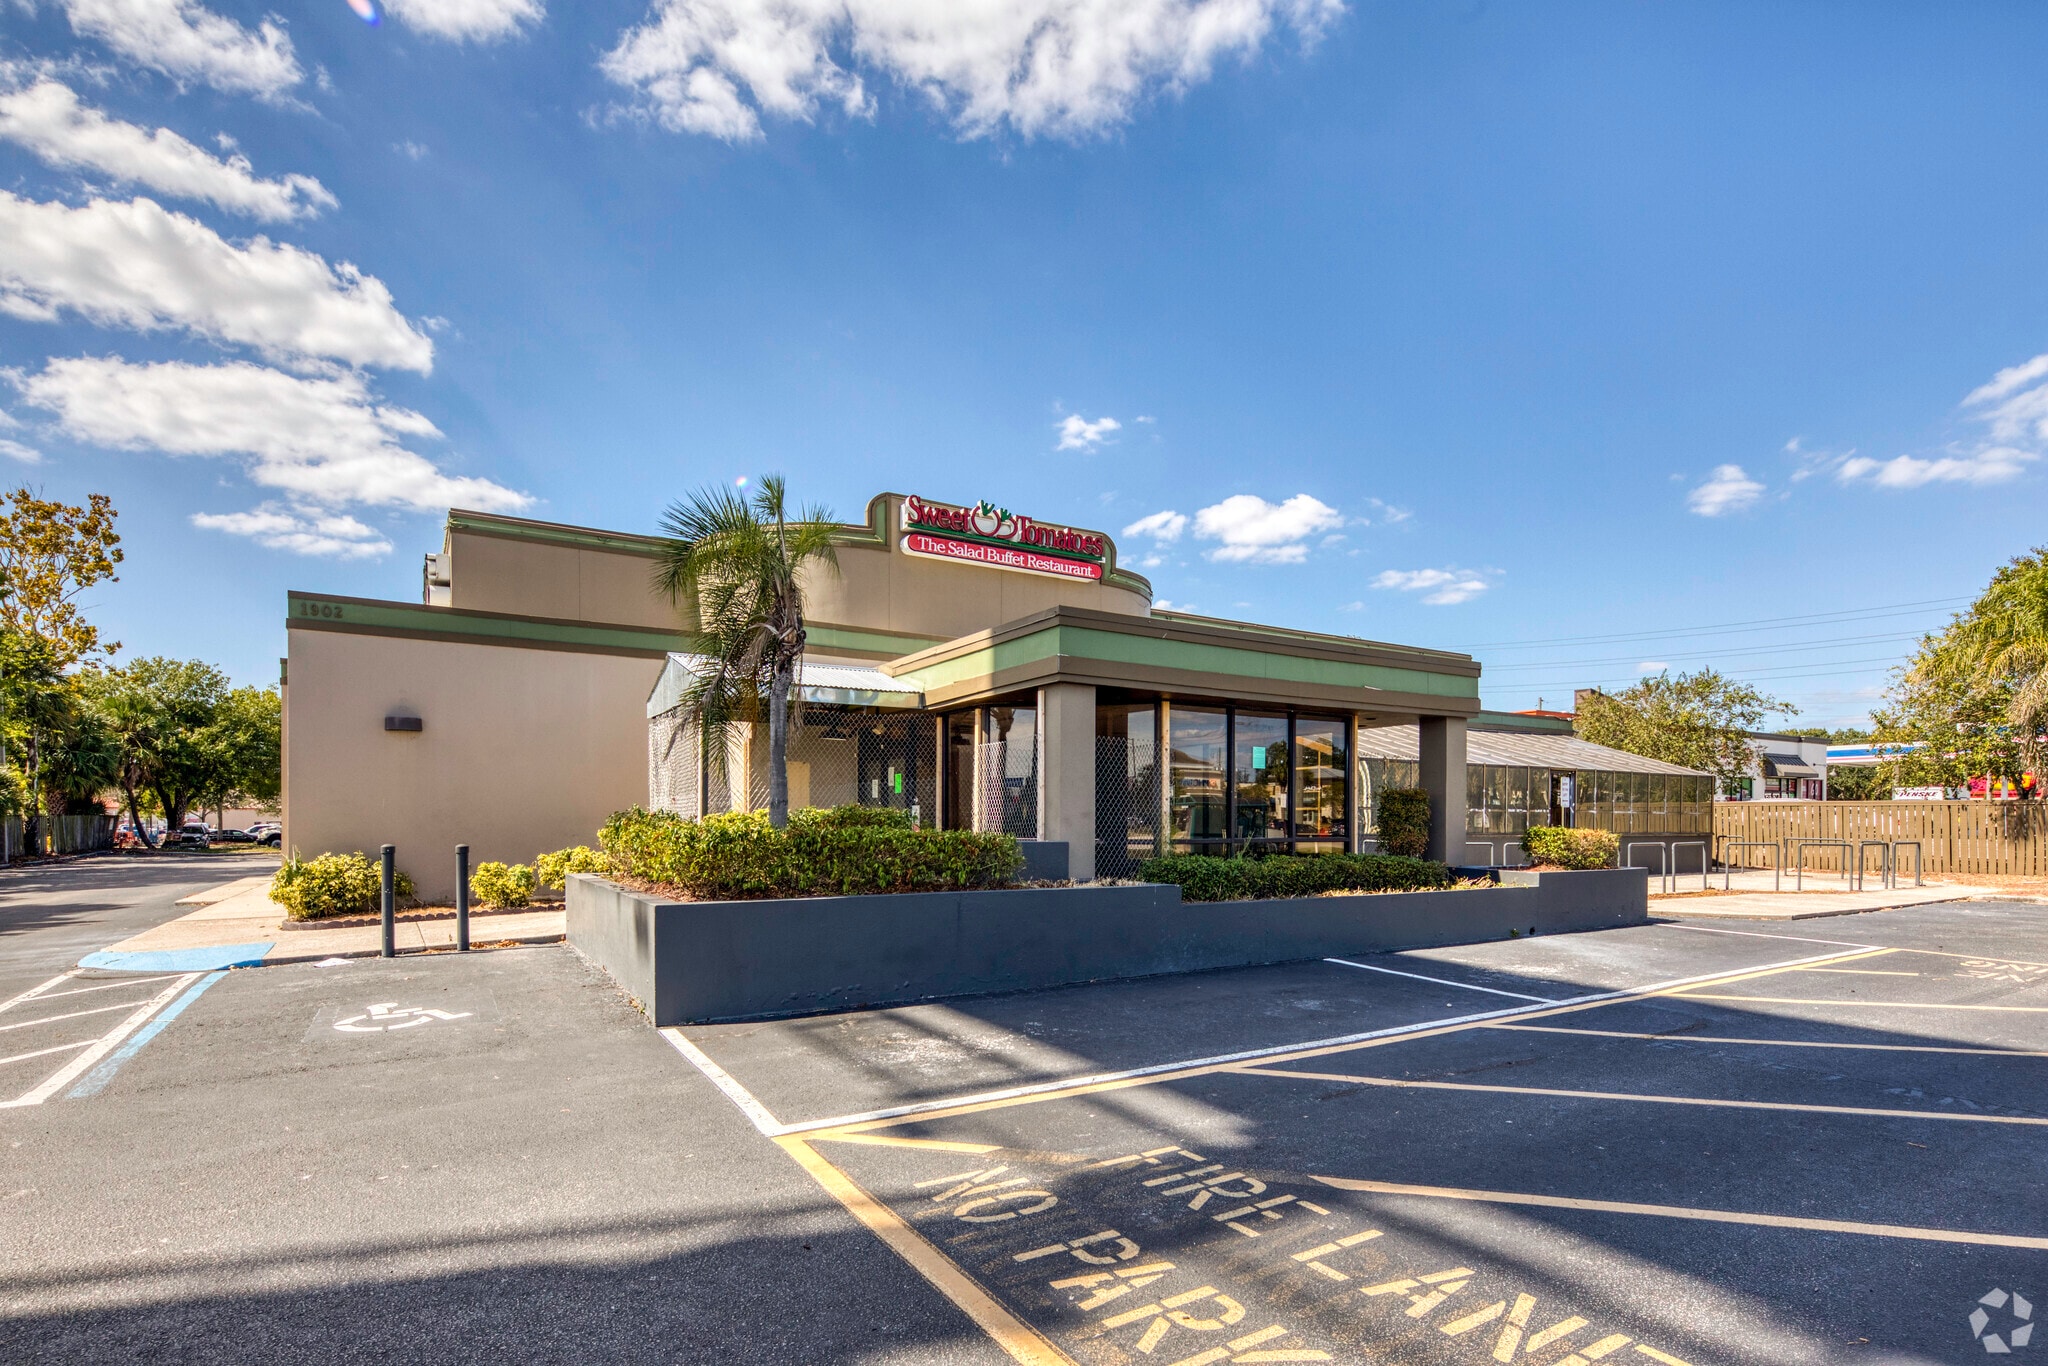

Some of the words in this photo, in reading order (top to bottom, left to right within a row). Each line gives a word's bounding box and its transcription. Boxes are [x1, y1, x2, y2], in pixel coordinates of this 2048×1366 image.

[906, 495, 971, 533] Sweet
[1016, 515, 1103, 556] Tomatoes
[918, 536, 946, 553] The
[948, 541, 984, 560] Salad
[987, 548, 1025, 567] Buffet
[1027, 554, 1095, 577] Restaurant.
[301, 602, 343, 619] 1902
[913, 1165, 1059, 1224] NO
[1085, 1145, 1332, 1238] FIRE
